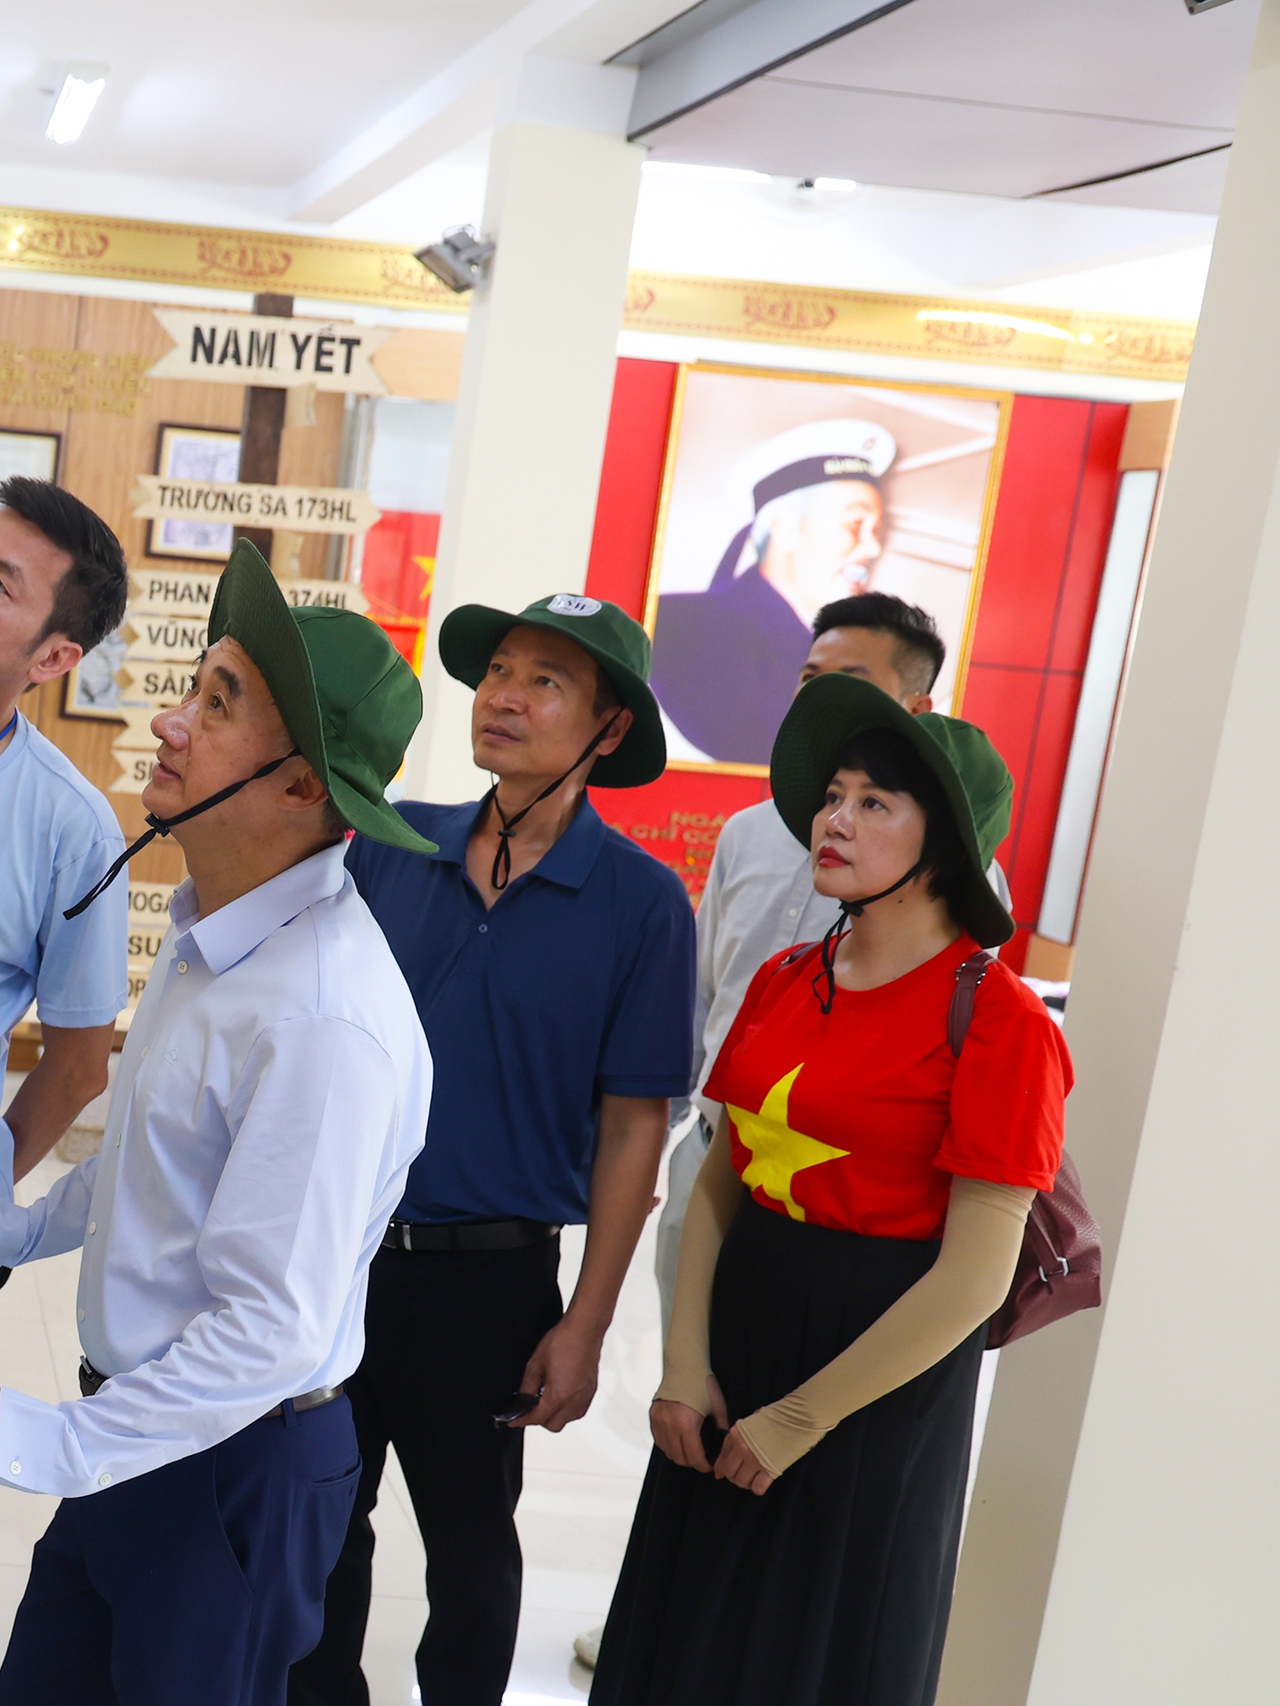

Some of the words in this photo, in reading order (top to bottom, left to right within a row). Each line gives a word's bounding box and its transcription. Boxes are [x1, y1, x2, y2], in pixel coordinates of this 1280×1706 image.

[191, 326, 276, 368] NAM
[290, 324, 361, 374] YẾT
[259, 494, 287, 517] SA
[296, 497, 357, 523] 173HL
[149, 580, 211, 604] PHAN
